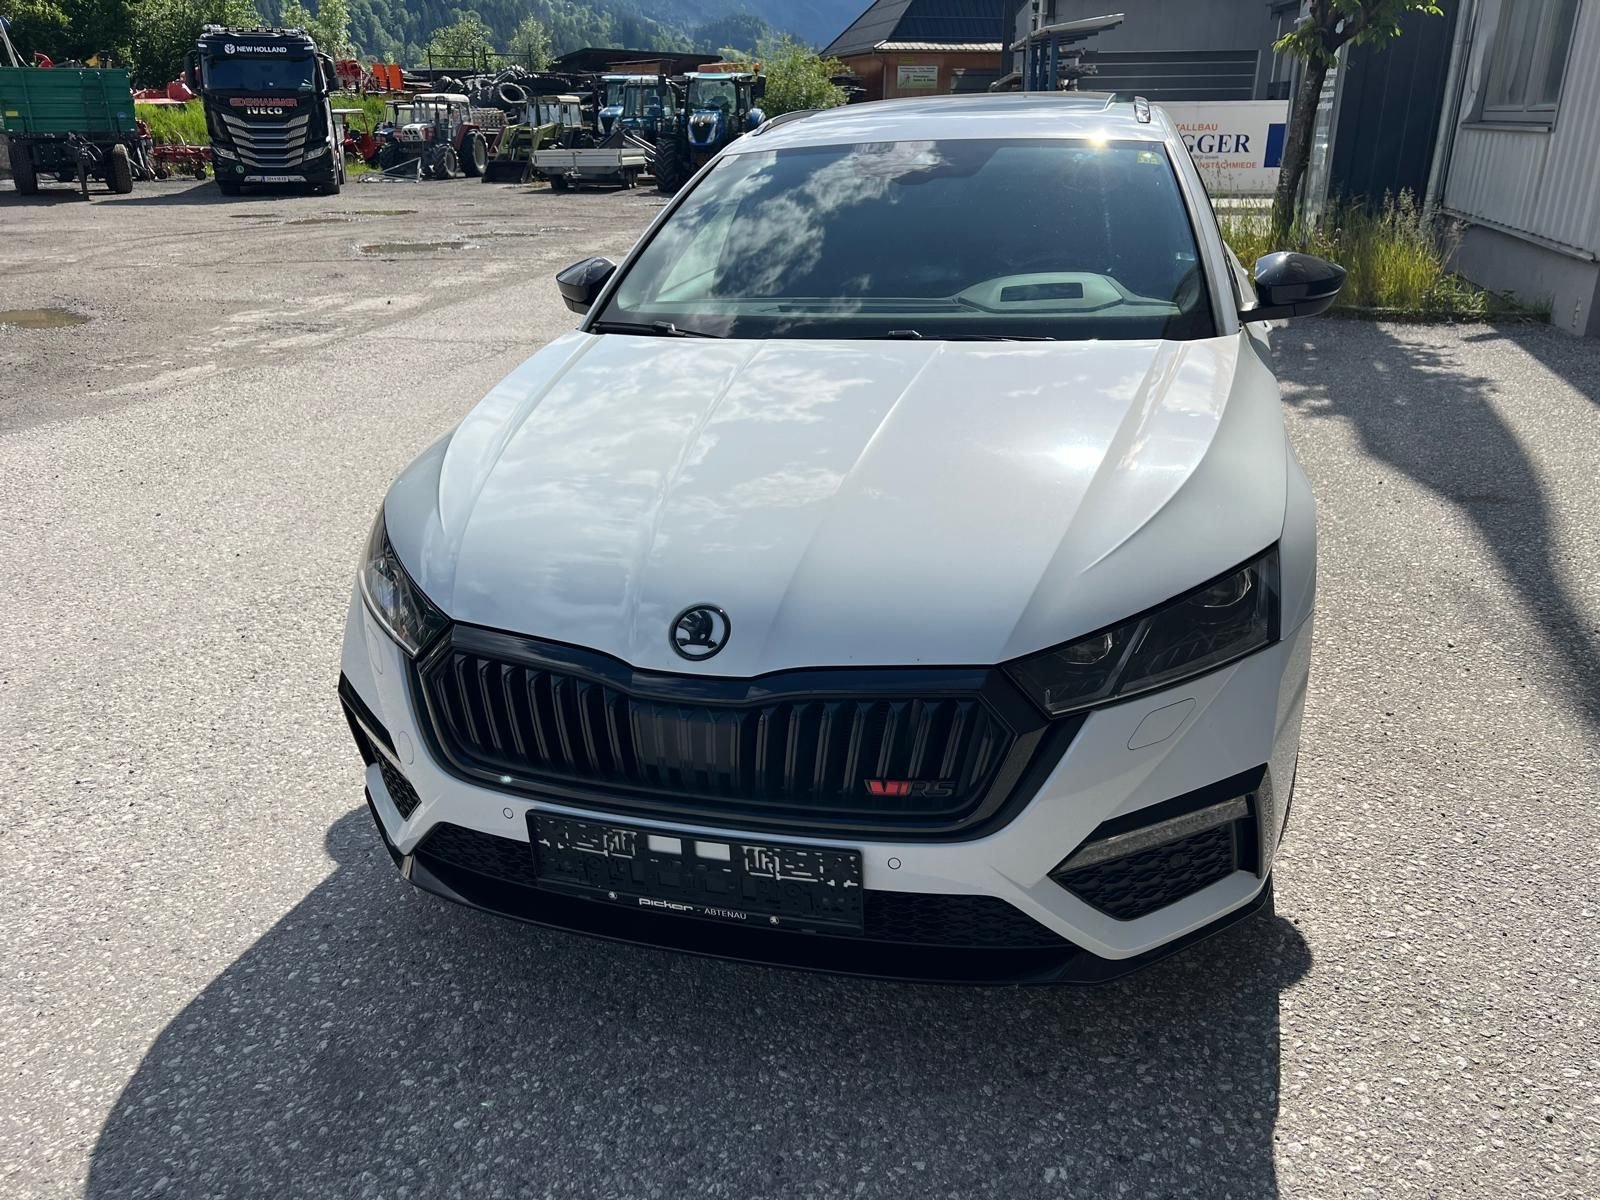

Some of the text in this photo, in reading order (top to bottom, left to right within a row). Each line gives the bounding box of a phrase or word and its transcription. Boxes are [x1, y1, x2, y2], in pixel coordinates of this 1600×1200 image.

[236, 45, 253, 53] NEW
[246, 106, 283, 115] IVECO
[704, 907, 747, 920] ABTENAU
